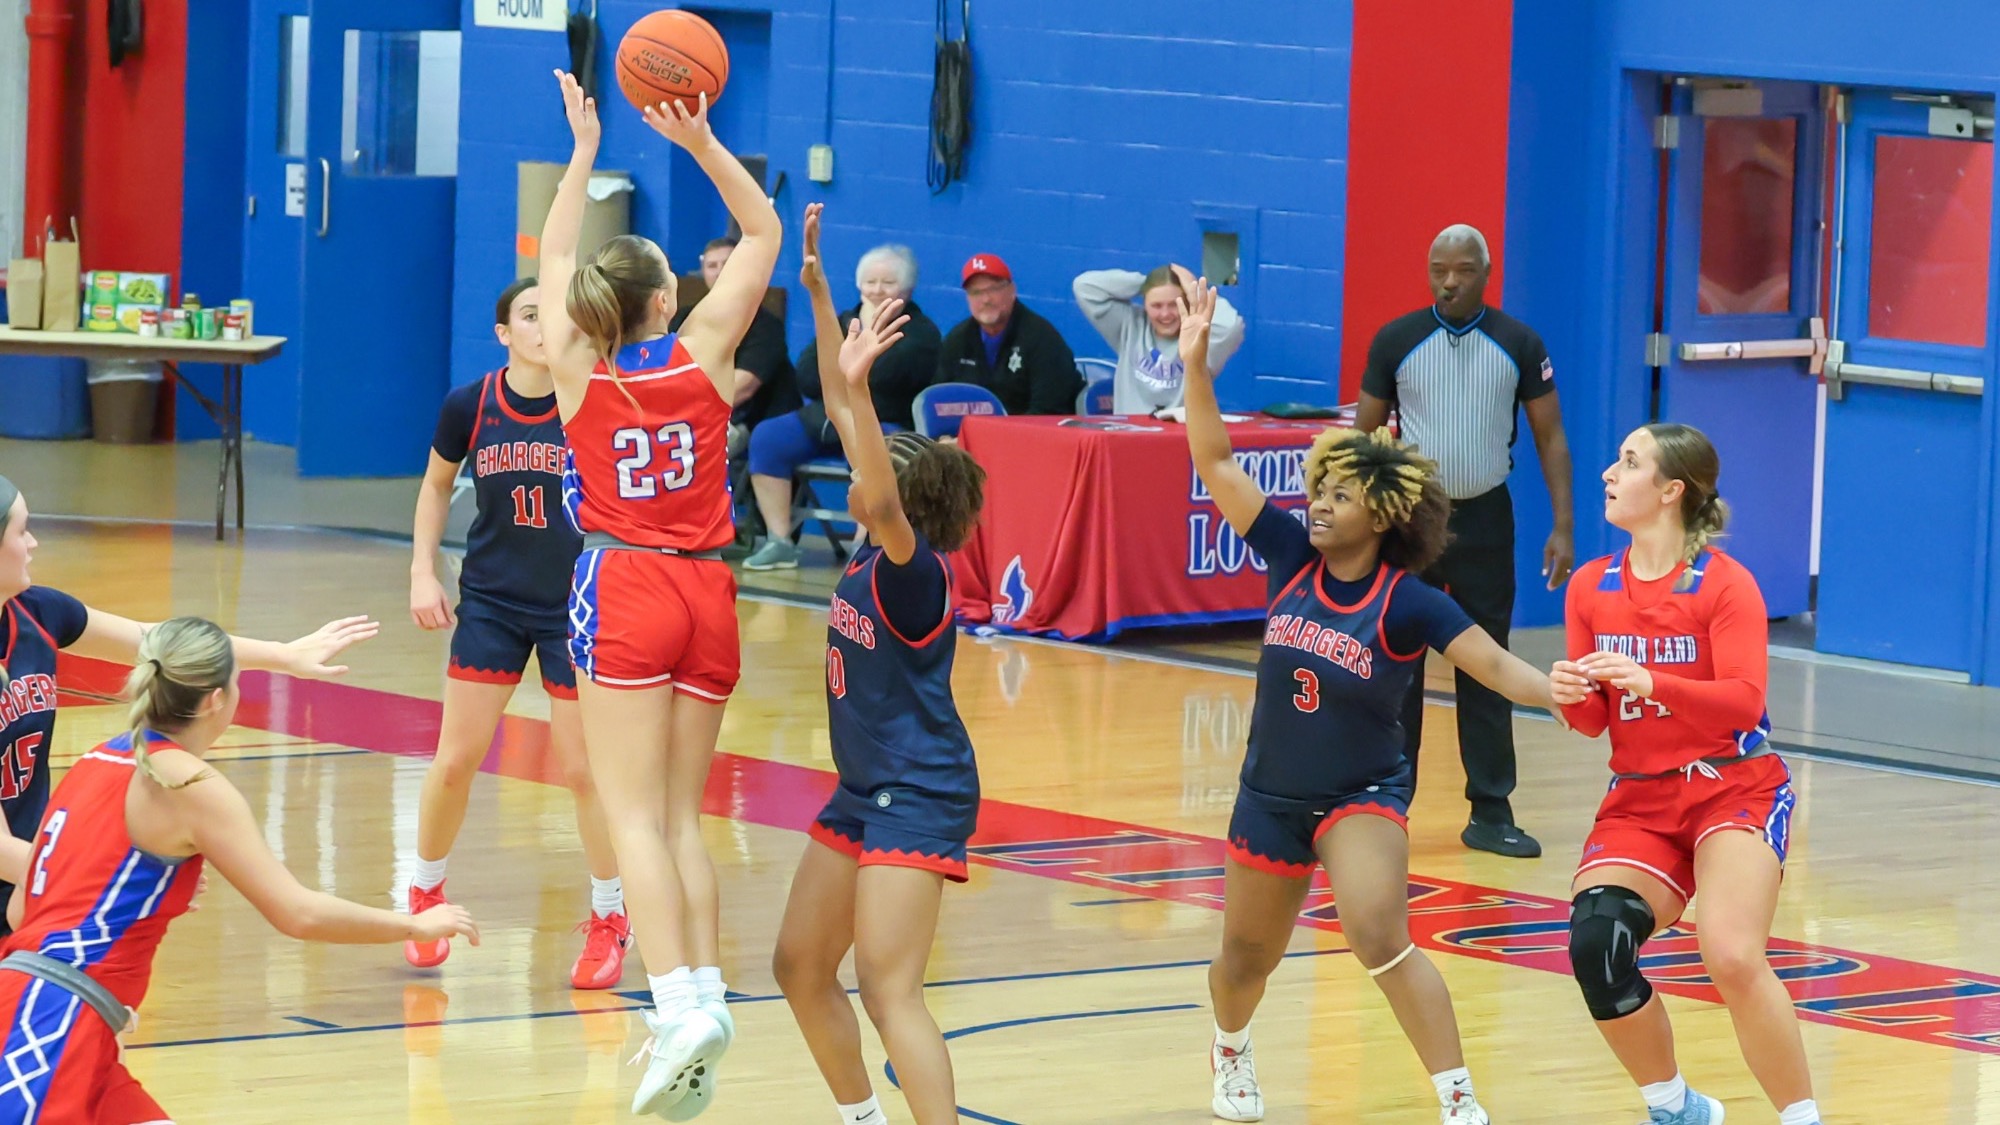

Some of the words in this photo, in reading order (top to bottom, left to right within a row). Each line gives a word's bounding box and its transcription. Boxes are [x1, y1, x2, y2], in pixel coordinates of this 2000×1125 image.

[631, 54, 693, 89] LEGACY
[612, 420, 696, 500] 23
[511, 485, 547, 529] 11
[1264, 614, 1373, 680] CHARGERS
[1653, 635, 1698, 663] LAND
[1293, 667, 1320, 714] 3
[0, 731, 44, 801] 15
[30, 807, 69, 898] 2
